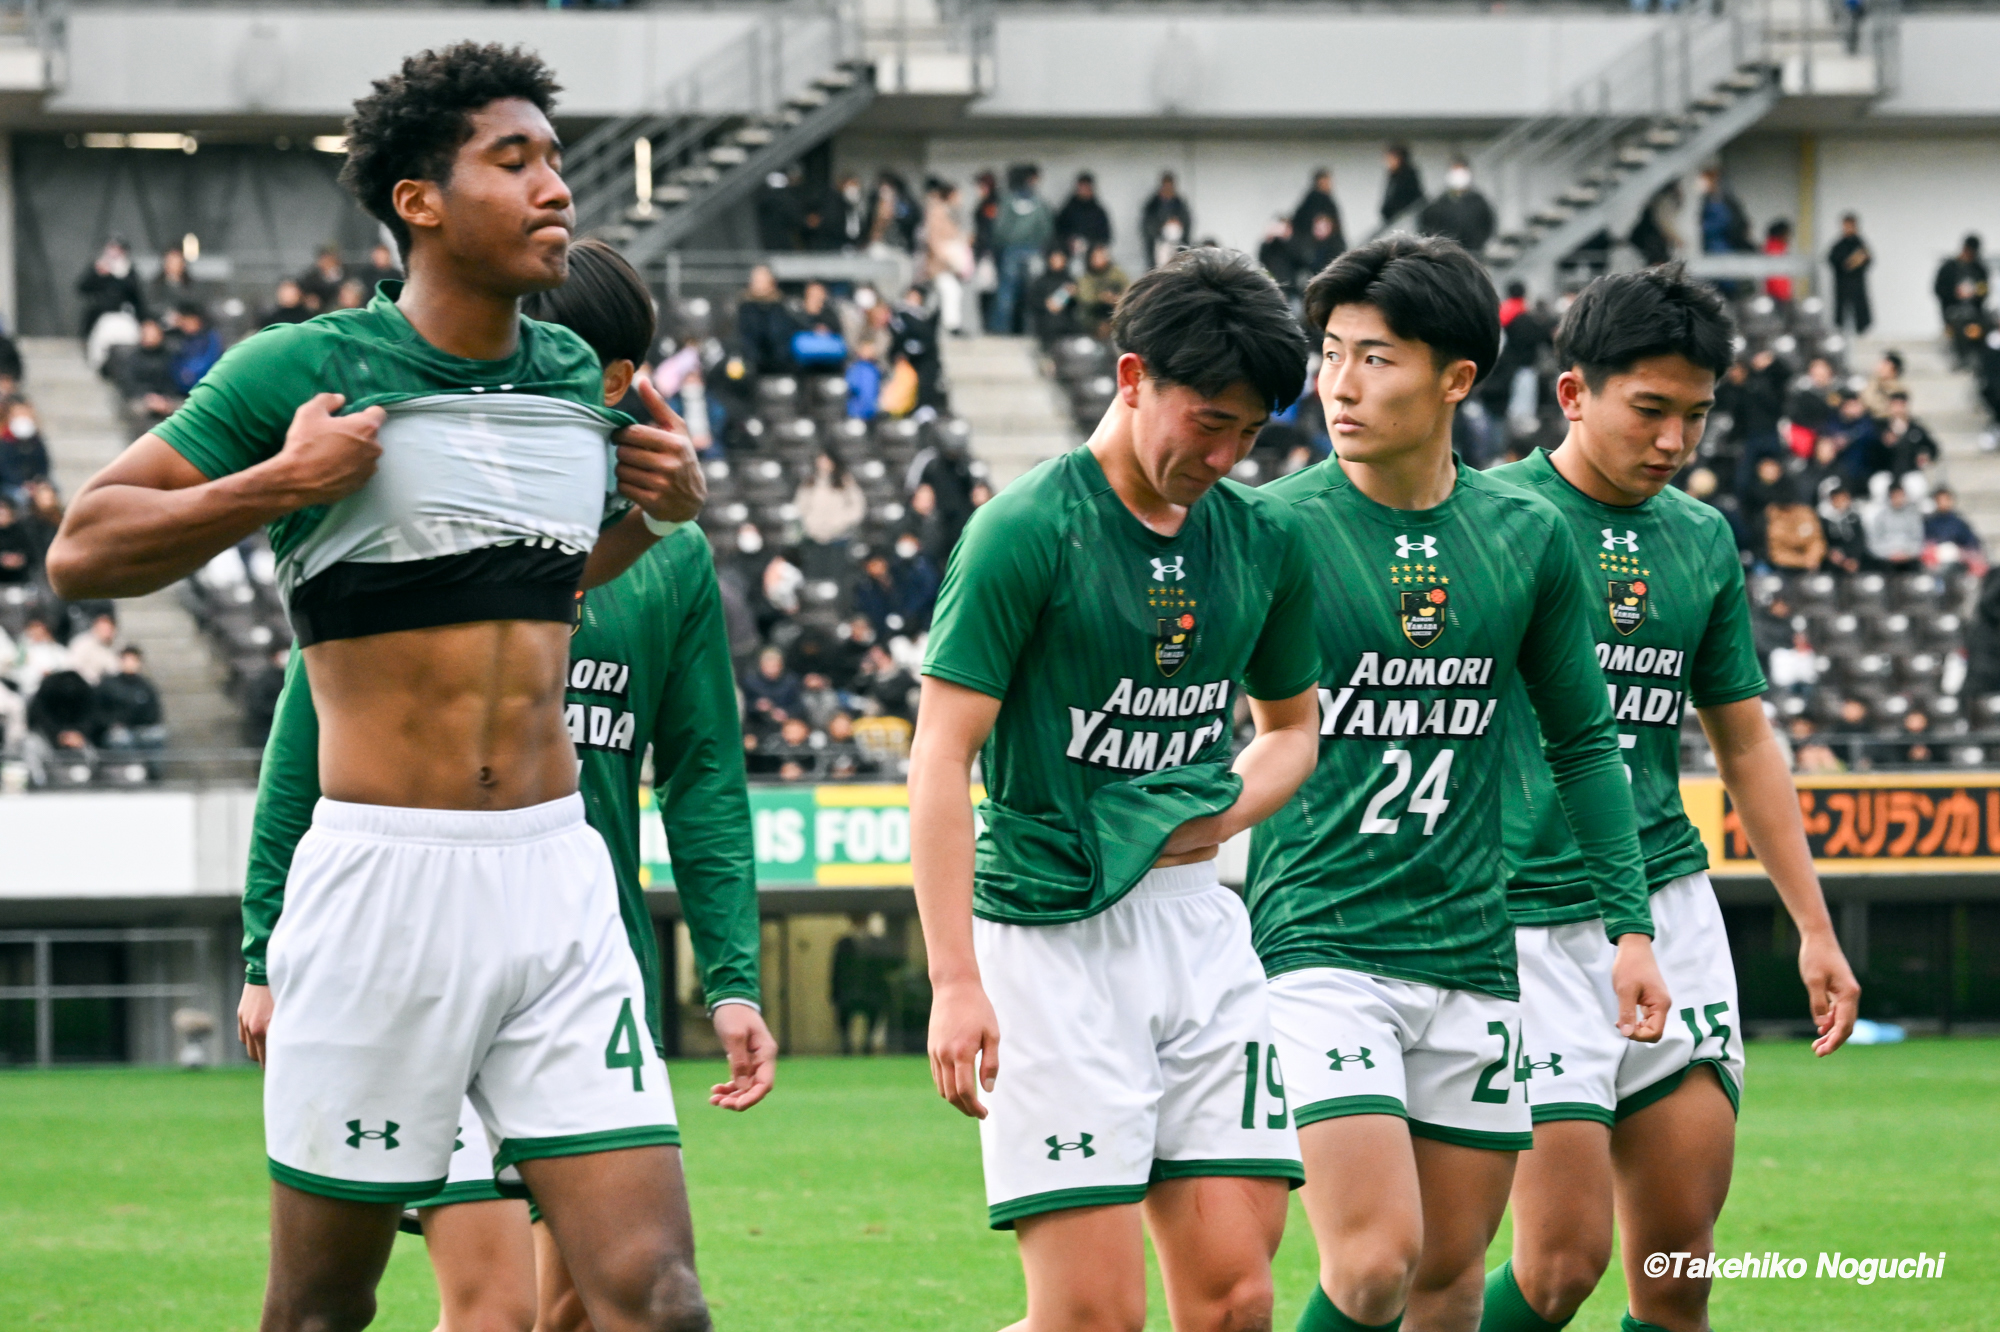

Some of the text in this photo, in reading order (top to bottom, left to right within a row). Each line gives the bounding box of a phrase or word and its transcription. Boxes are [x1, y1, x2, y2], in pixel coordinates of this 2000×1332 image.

[565, 658, 629, 694] ORI
[1102, 677, 1230, 718] AOMORI
[1349, 652, 1493, 687] AOMORI
[1317, 687, 1497, 736] YAMADA
[1358, 748, 1455, 836] 24
[755, 807, 806, 864] IS
[605, 997, 645, 1092] 4
[1679, 1000, 1730, 1061] 15
[1241, 1041, 1288, 1129] 19
